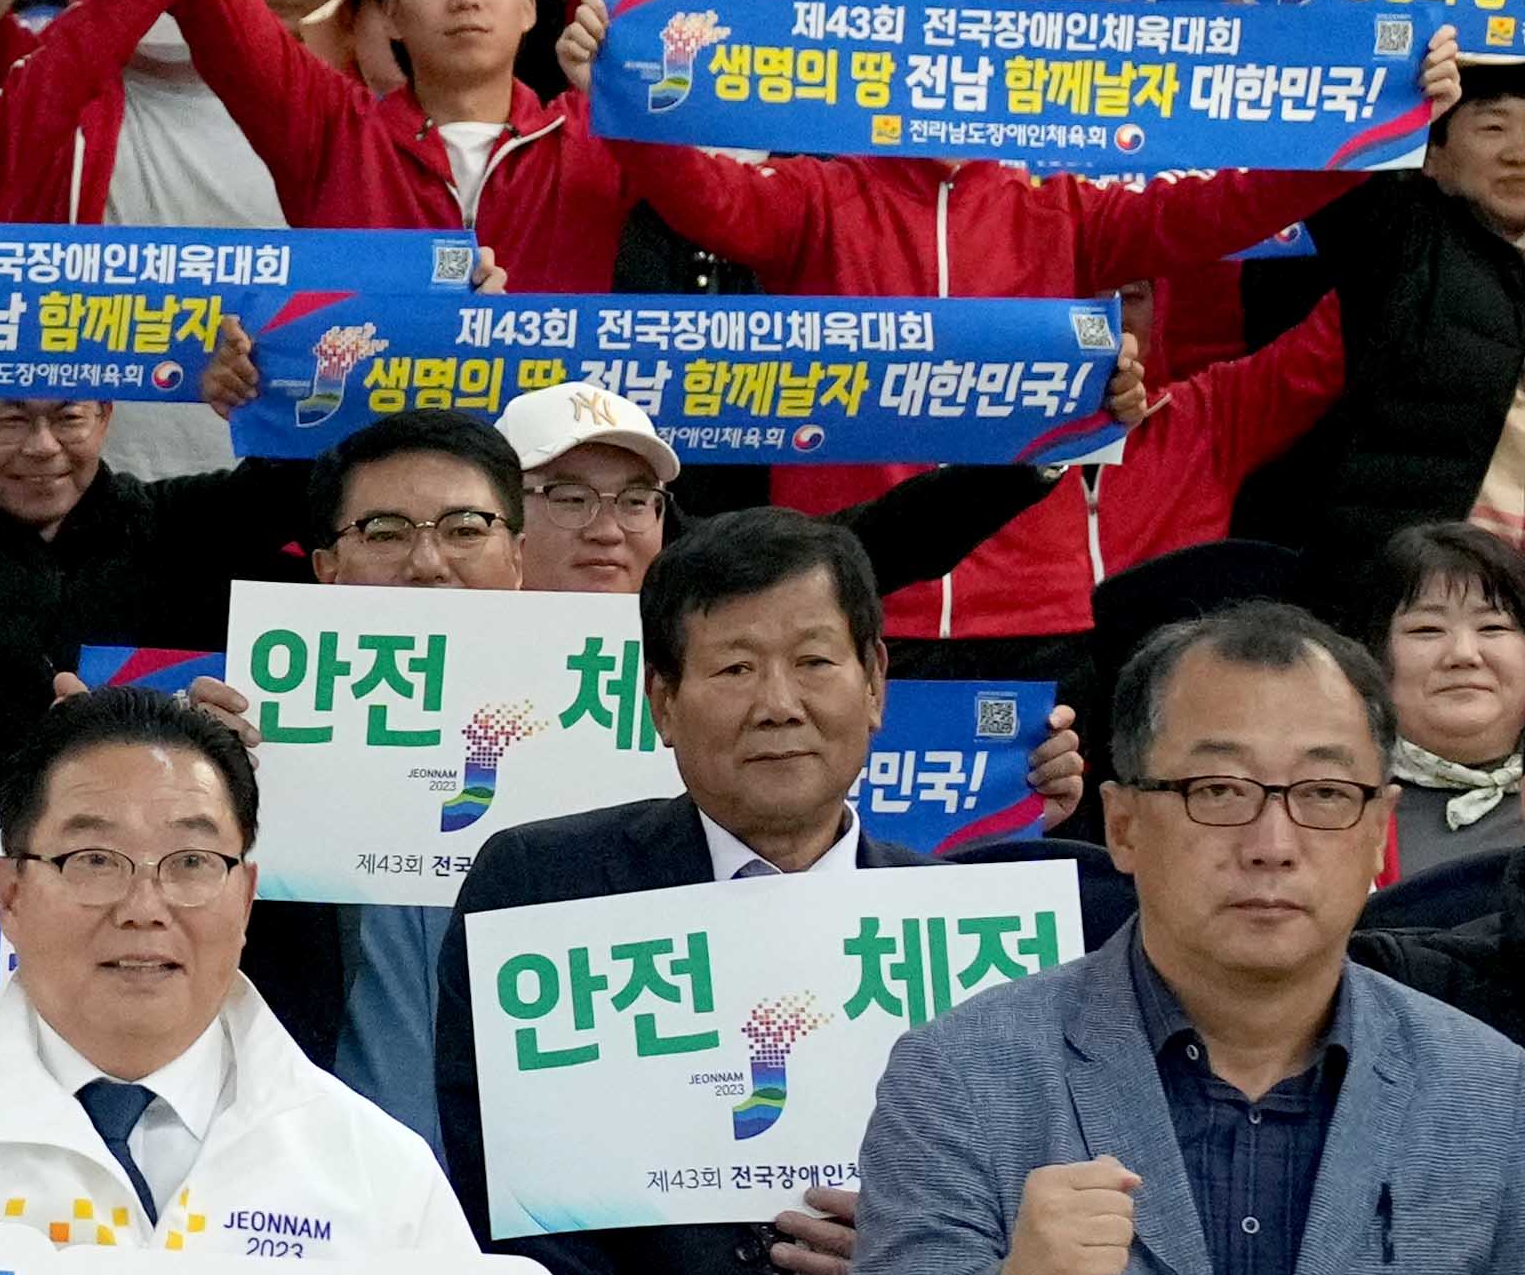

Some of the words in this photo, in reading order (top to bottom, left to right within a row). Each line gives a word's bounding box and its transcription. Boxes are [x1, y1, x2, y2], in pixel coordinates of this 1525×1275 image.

[792, 2, 905, 43] 제43회
[924, 8, 1240, 55] 전국장애인체육대회
[709, 45, 837, 104] 생명의
[851, 52, 896, 108] 땅
[906, 55, 994, 111] 전남
[1005, 55, 1180, 117] 함께날자
[1190, 64, 1386, 122] 대한민국!
[909, 120, 1107, 149] 전라남도장애인체육회
[39, 291, 232, 356] 함께날자
[244, 629, 446, 753] 안전
[559, 631, 662, 752] 체
[408, 769, 457, 778] JEONNAM
[429, 781, 456, 791] 2023
[356, 854, 422, 876] 제43회
[497, 932, 719, 1071] 안전
[689, 1072, 743, 1084] JEONNAM
[715, 1084, 745, 1096] 2023
[646, 1166, 723, 1193] 제43회
[224, 1211, 330, 1249] JEONNAM
